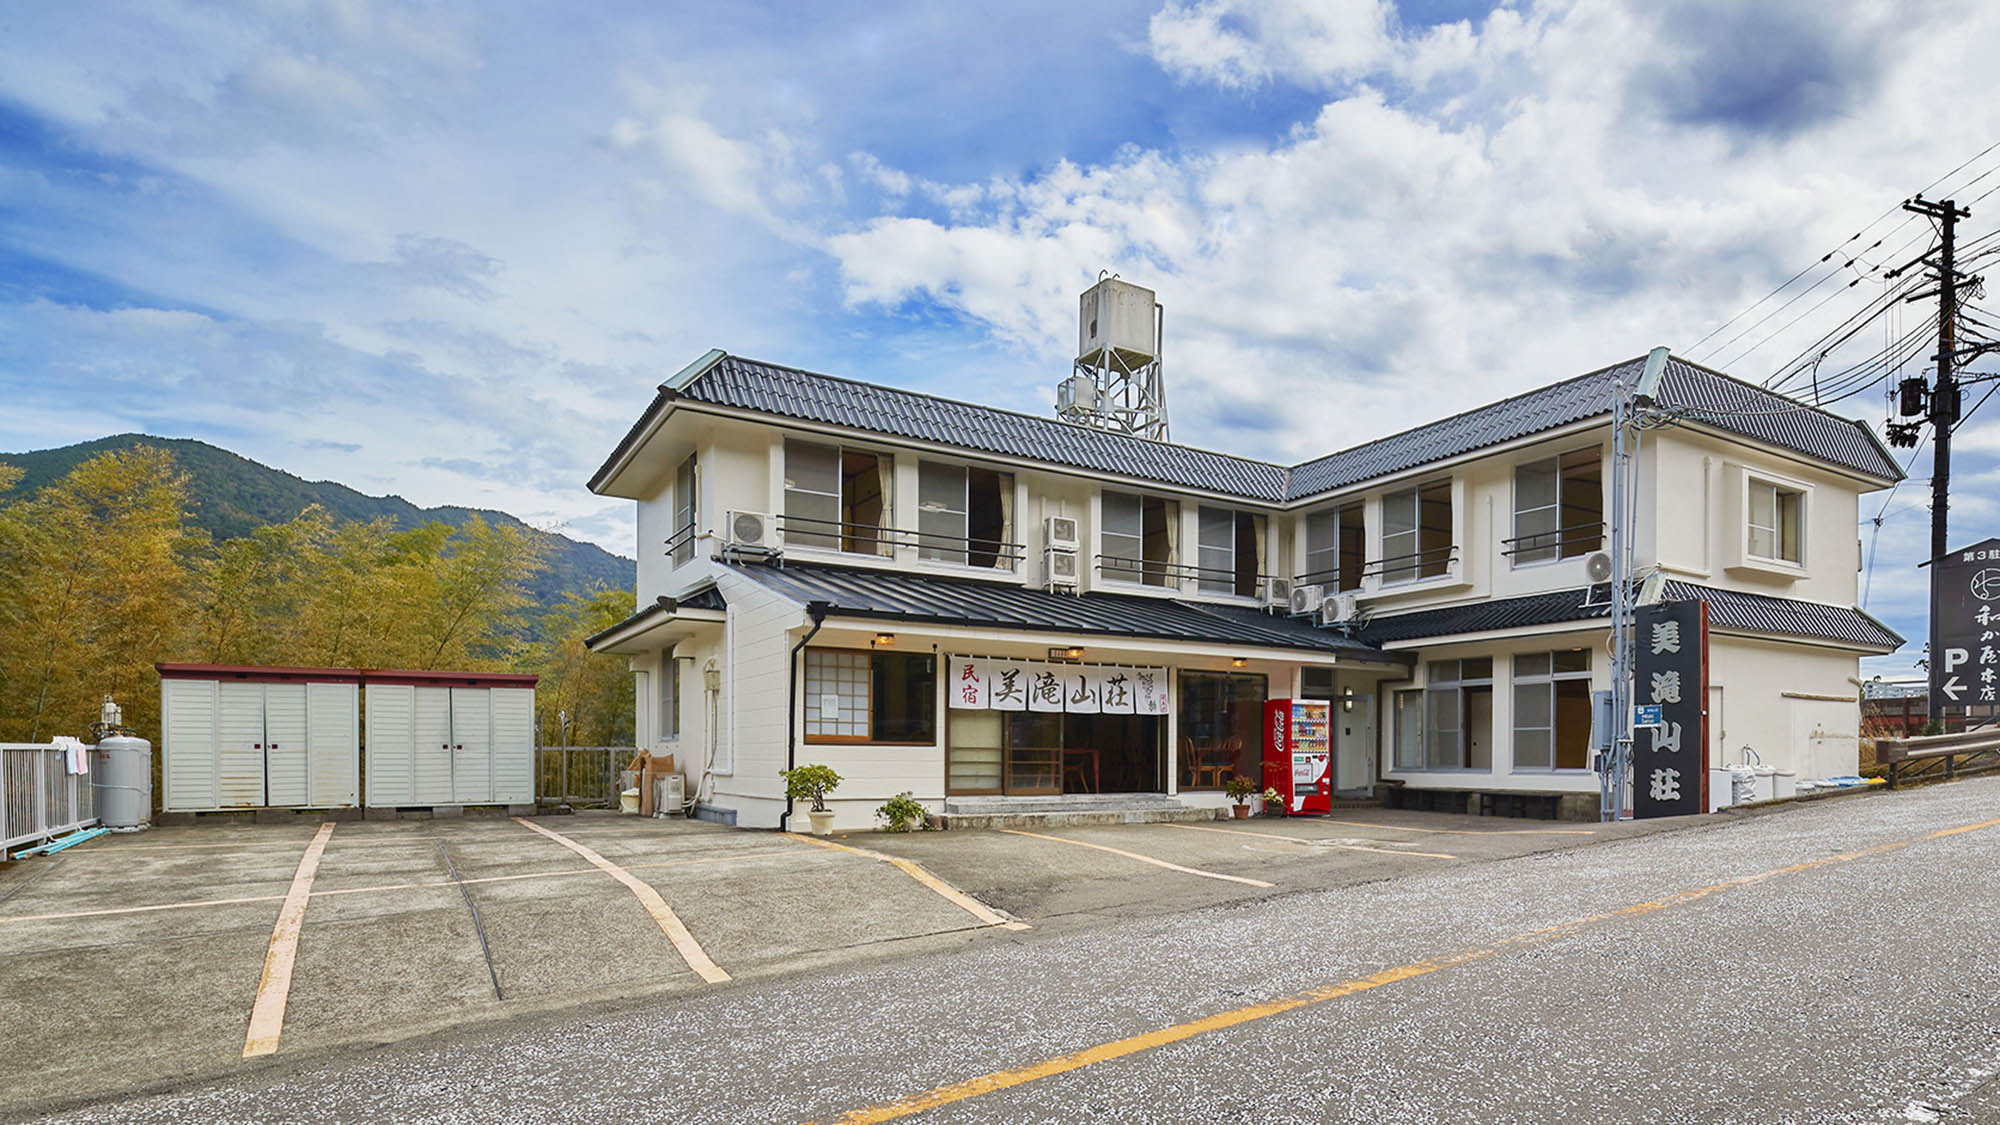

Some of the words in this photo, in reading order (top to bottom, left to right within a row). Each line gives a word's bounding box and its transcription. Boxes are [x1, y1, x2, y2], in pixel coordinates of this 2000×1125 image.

[1944, 648, 1970, 673] P
[961, 664, 980, 705] 民宿
[994, 667, 1129, 708] 美滝山荘
[1650, 620, 1682, 801] 美滝山荘
